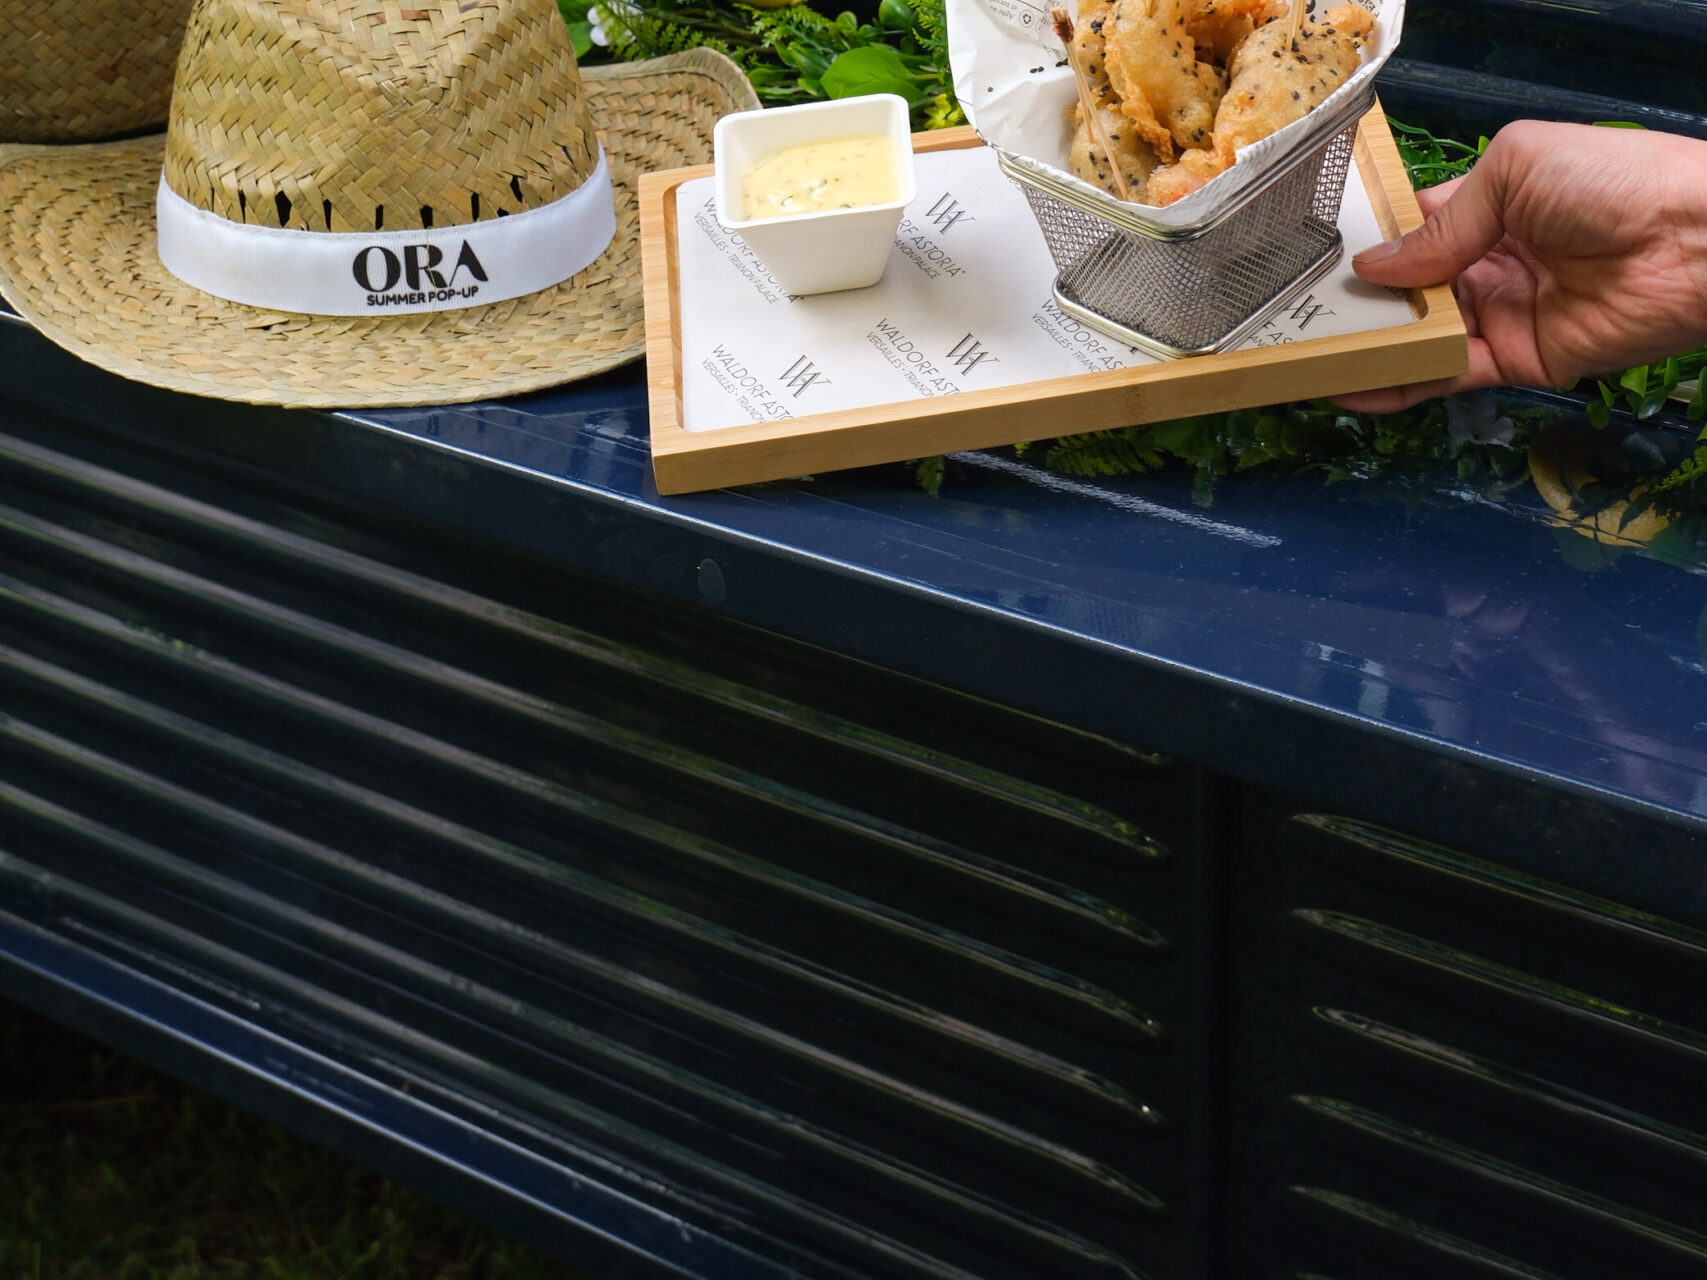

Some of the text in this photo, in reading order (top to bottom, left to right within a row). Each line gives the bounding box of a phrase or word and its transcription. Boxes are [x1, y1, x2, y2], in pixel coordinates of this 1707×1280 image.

[694, 212, 729, 251] VERSAILLES
[353, 239, 489, 292] ORA
[367, 286, 479, 306] SUMMER POP-UP
[1032, 313, 1072, 351] VERSAILLES
[1041, 299, 1107, 354] WALDORF
[866, 331, 904, 369] VERSAILLES
[876, 318, 939, 375] WALDORF
[702, 358, 738, 394] VERSAILLES
[712, 343, 771, 399] WALDORF
